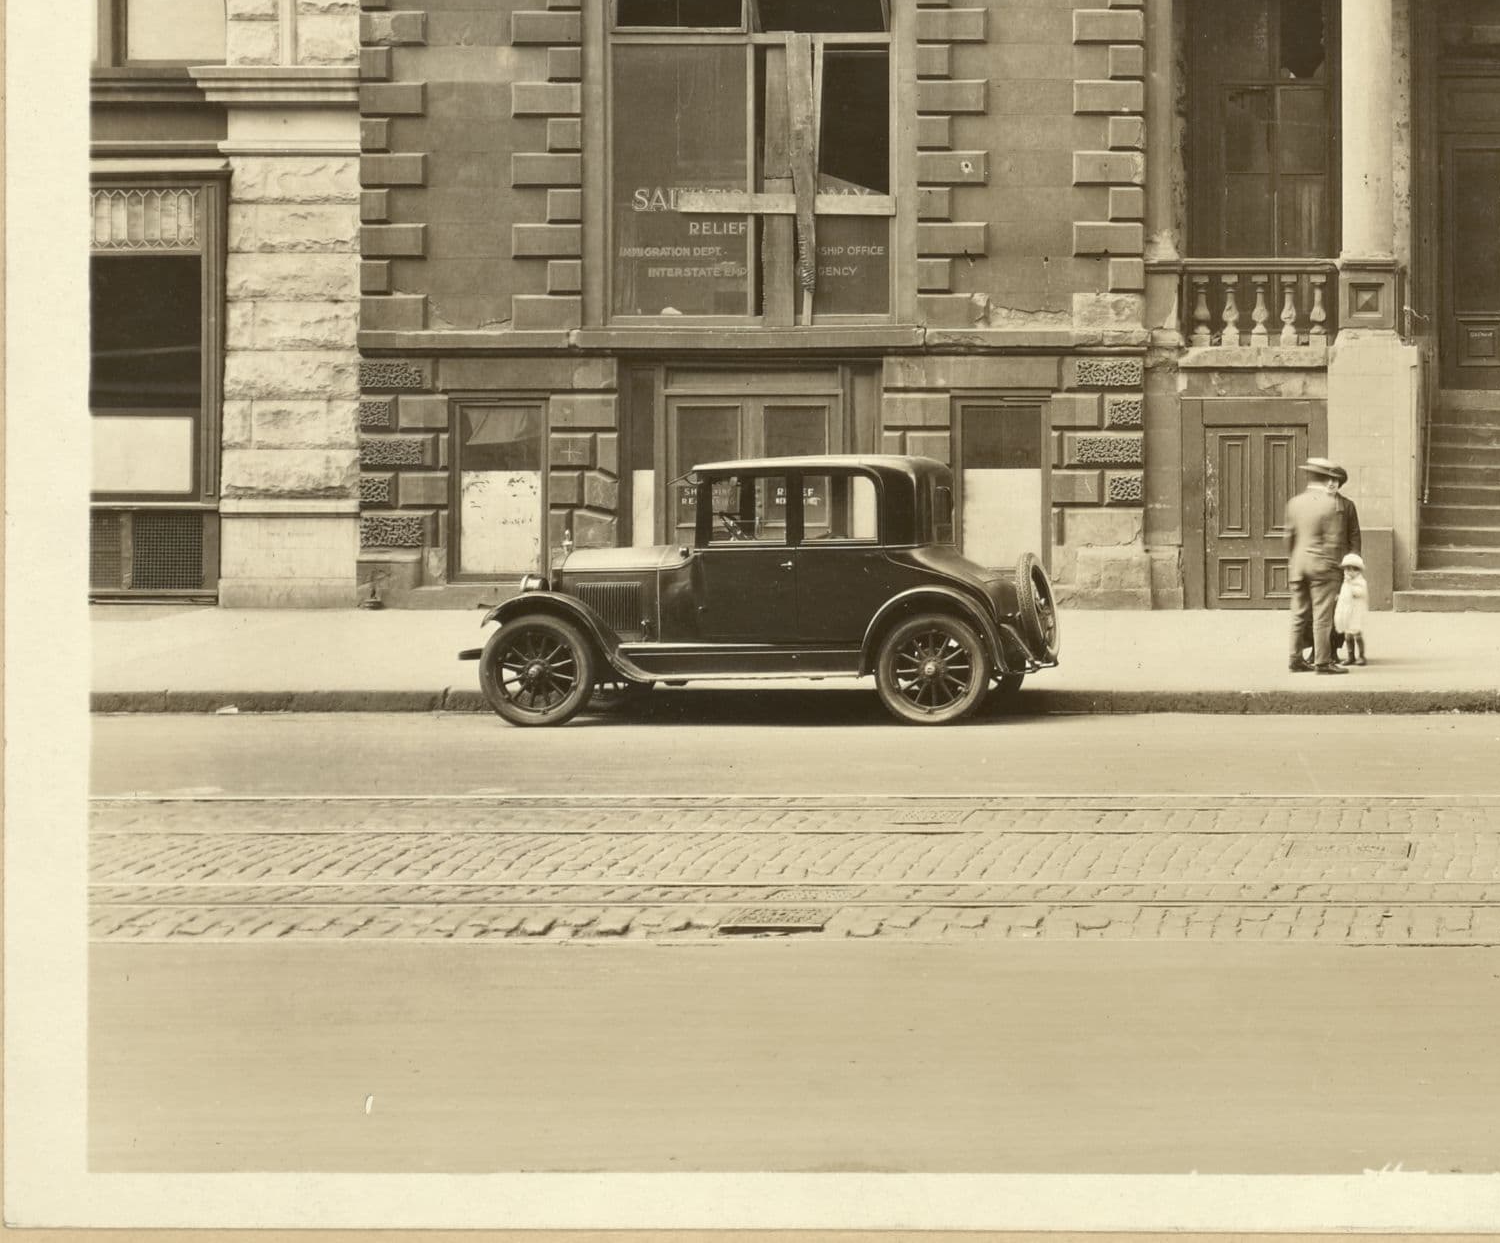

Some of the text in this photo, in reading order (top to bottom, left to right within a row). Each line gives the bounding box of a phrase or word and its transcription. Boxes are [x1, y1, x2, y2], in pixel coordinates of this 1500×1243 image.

[689, 221, 748, 235] RELIEF
[619, 246, 690, 257] IMMIGRATION
[847, 246, 885, 255] OFFICE
[648, 267, 720, 277] INTERSTATE
